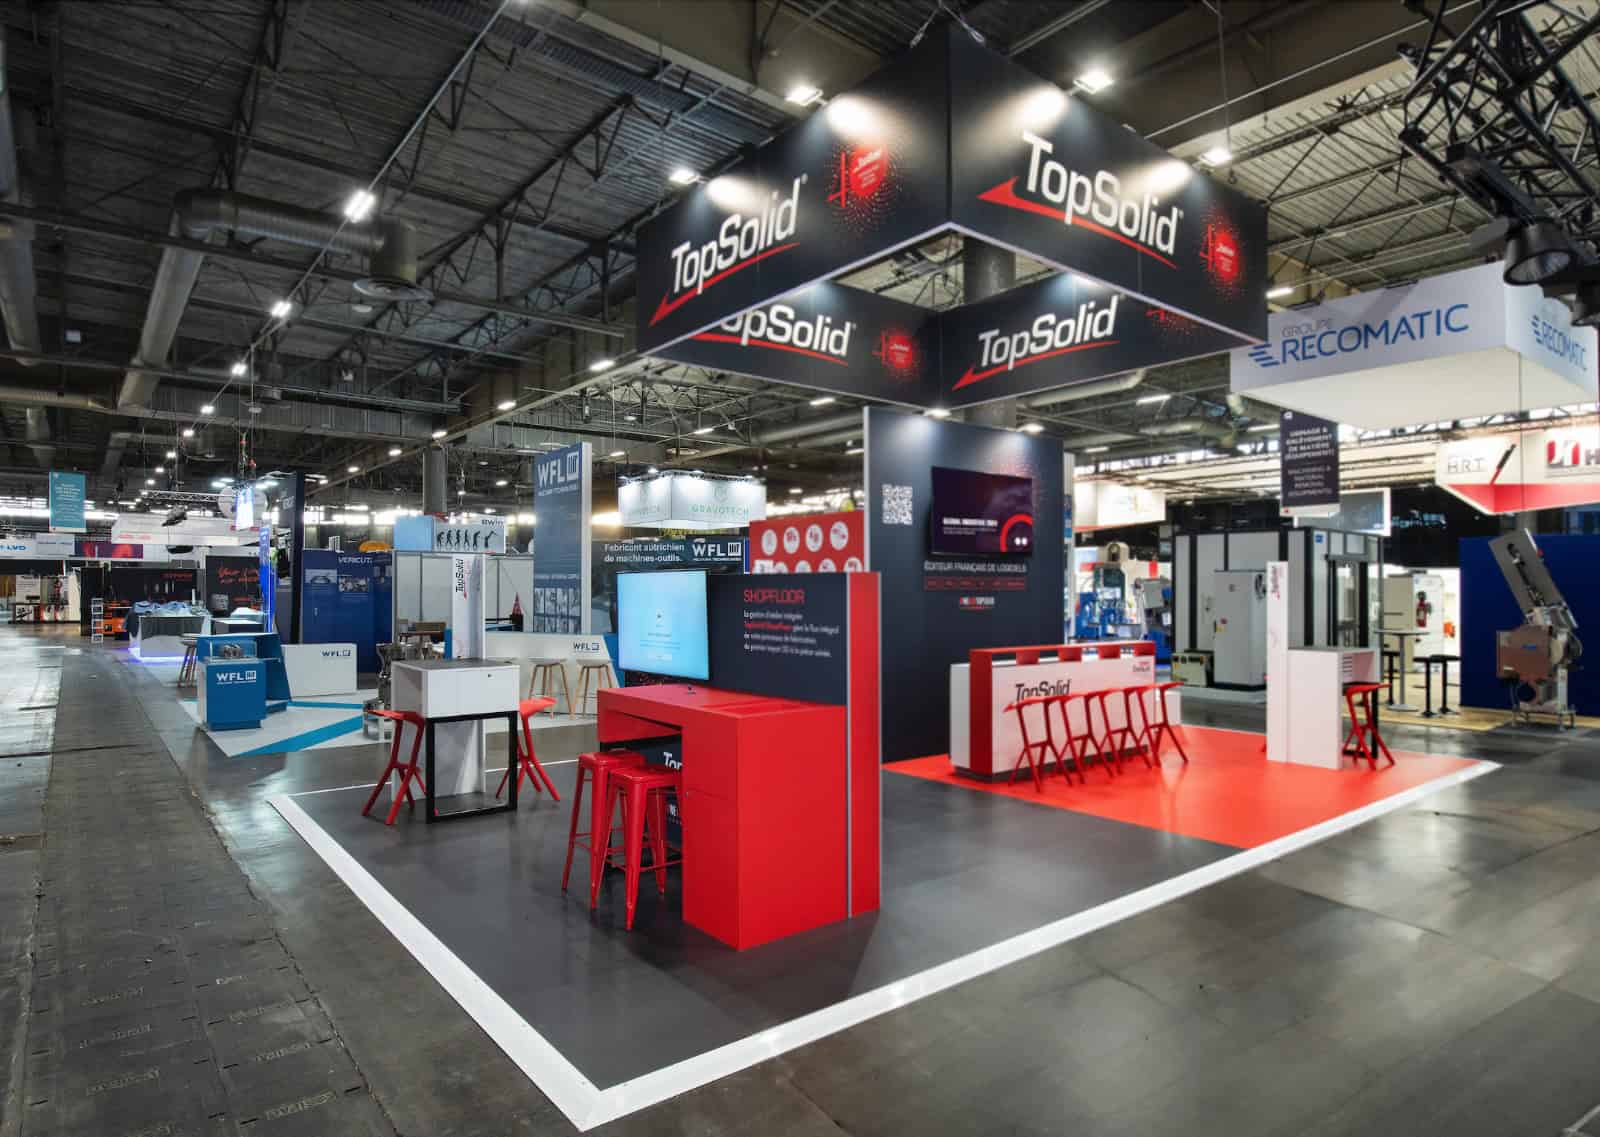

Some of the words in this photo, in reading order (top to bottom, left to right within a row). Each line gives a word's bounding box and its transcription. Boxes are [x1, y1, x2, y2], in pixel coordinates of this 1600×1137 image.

[1022, 131, 1183, 255] TopSolid
[670, 180, 801, 295] TopSolid
[978, 294, 1119, 369] TopSolid
[1281, 303, 1470, 365] RECOMATIC
[537, 459, 566, 488] WFL
[604, 554, 615, 563] de
[692, 543, 727, 557] WFL
[455, 558, 466, 593] TopSolid
[743, 588, 805, 604] SHOPFLOOR
[216, 672, 244, 681] WFL
